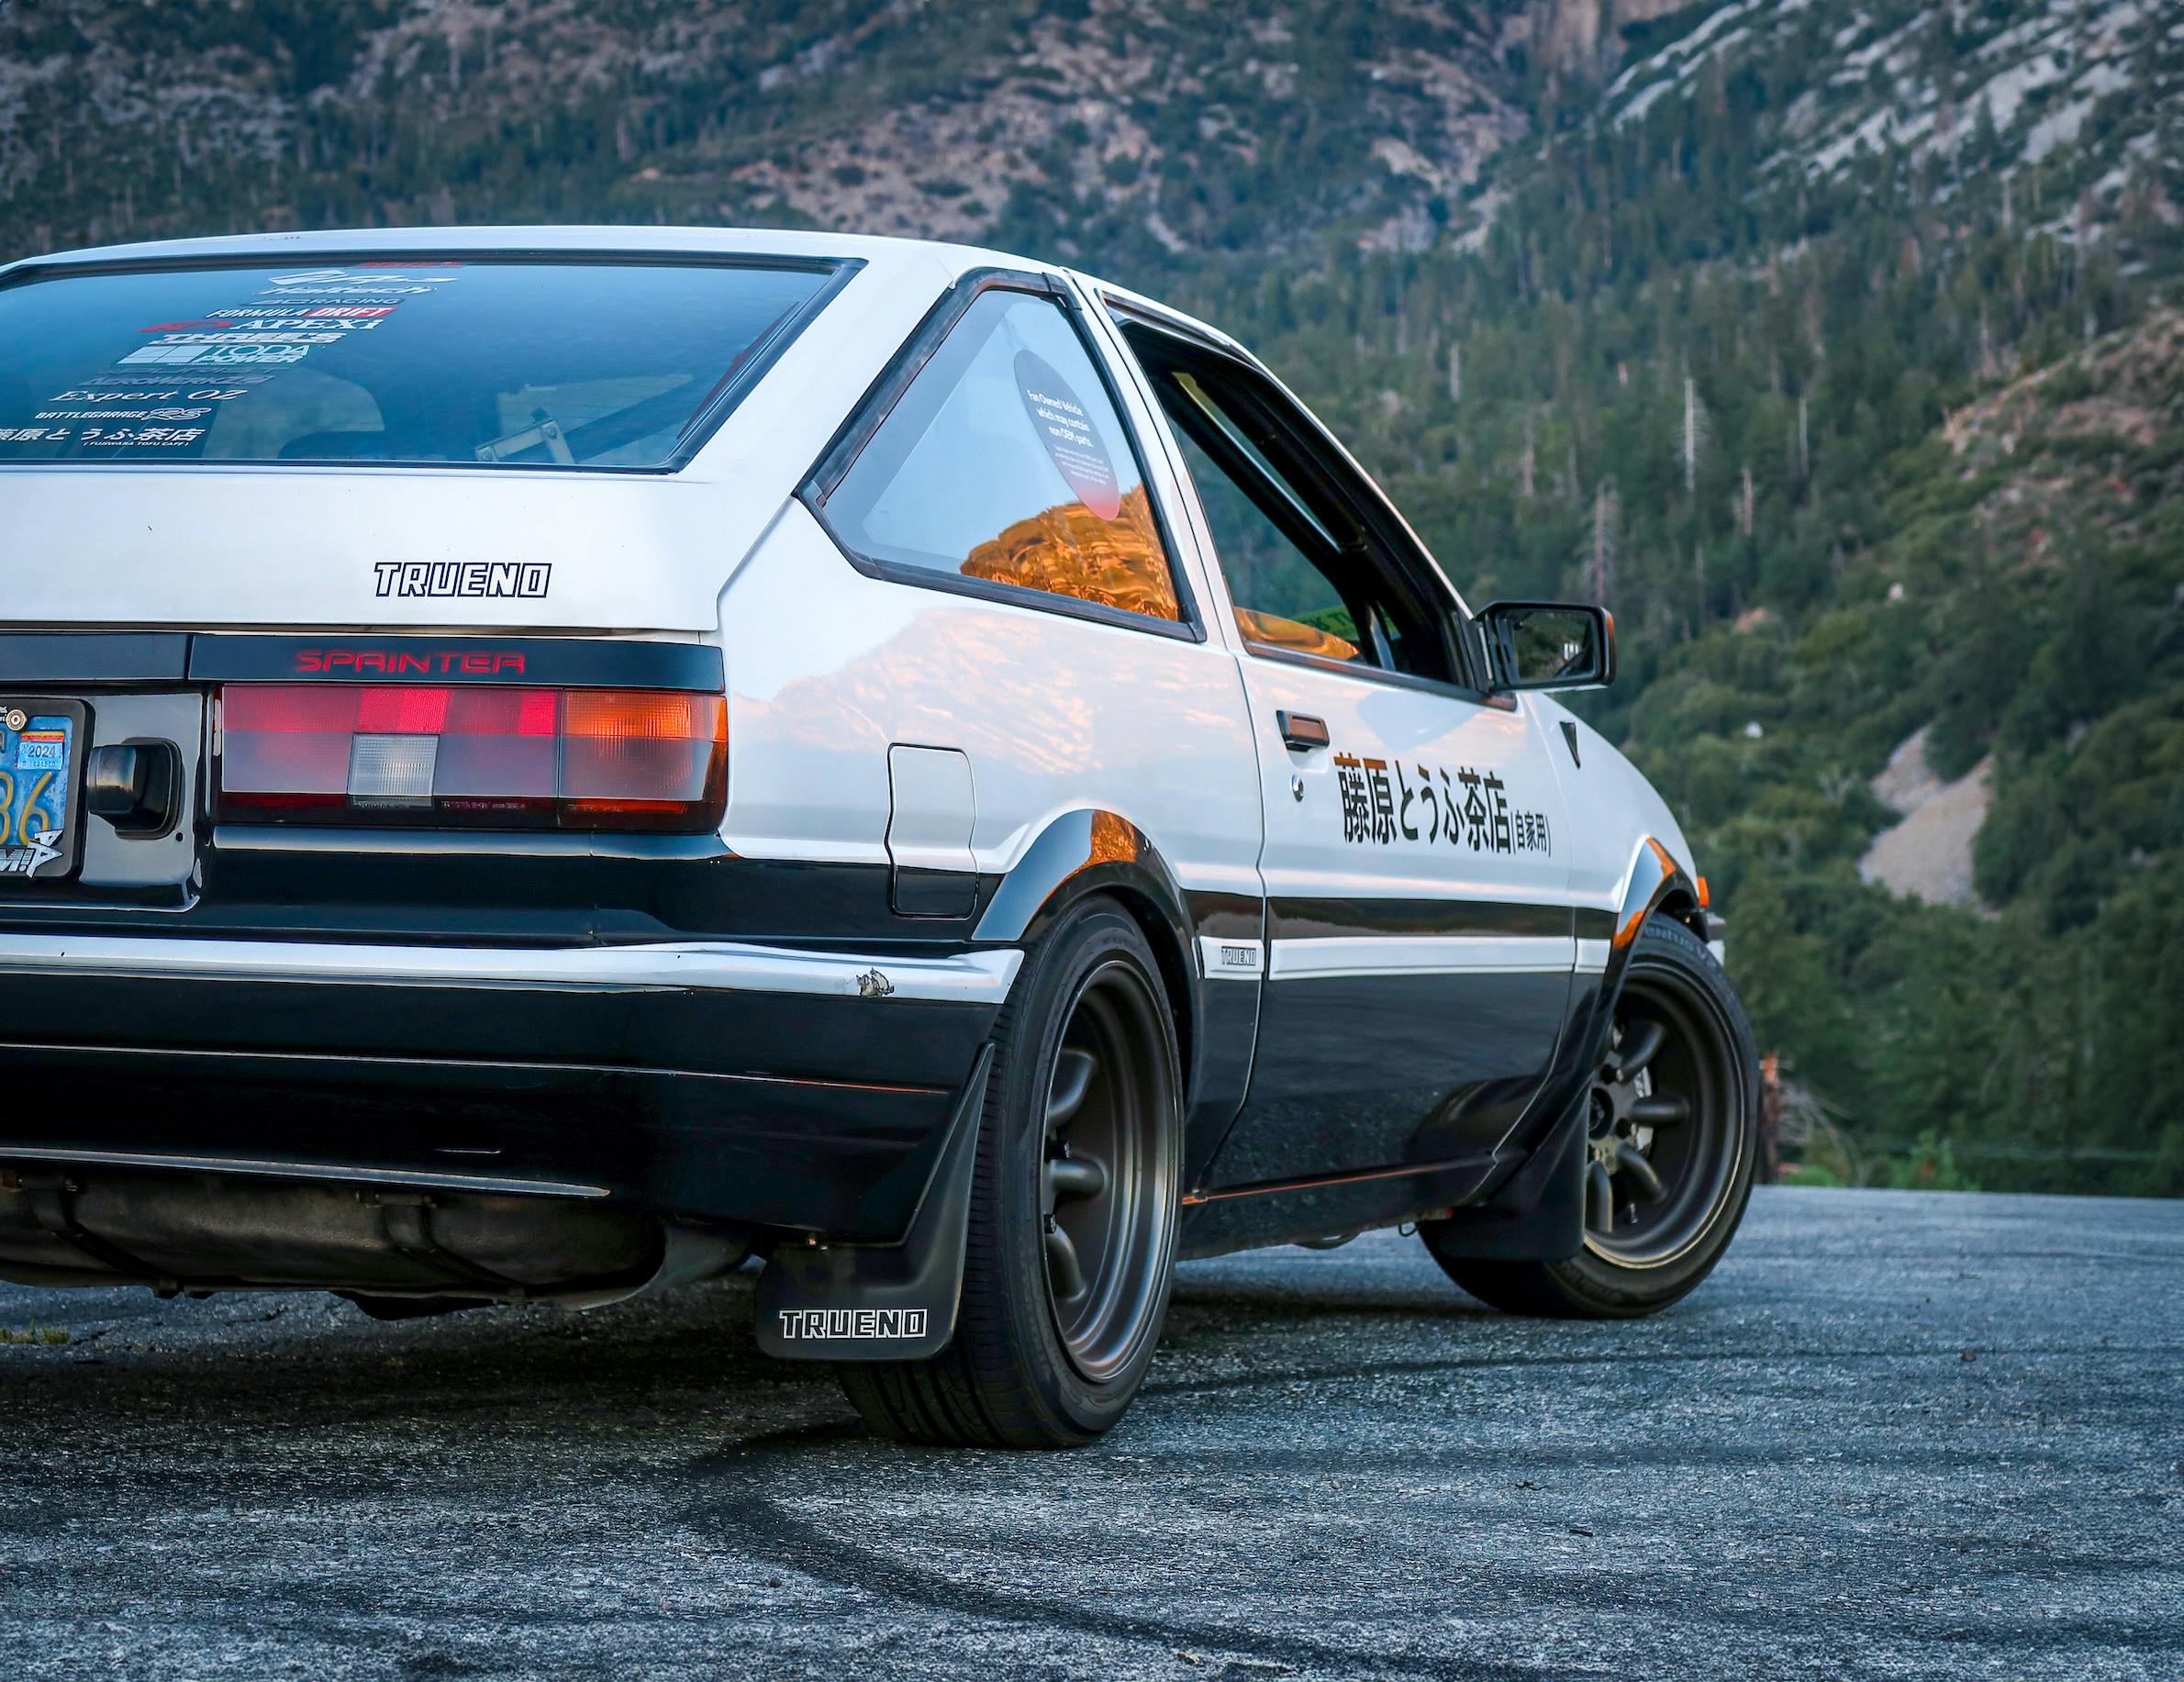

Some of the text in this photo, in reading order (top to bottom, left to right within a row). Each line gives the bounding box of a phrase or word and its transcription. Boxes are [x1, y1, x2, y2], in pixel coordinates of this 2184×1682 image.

[206, 306, 393, 318] FORMULA DRIFT
[213, 344, 310, 356] TODA
[193, 354, 304, 363] POWER
[49, 390, 179, 402] Expert
[35, 411, 147, 419] BATTLEGARAGE
[374, 562, 552, 598] TRUENO
[294, 650, 527, 675] SPRINTER
[28, 745, 56, 758] 2024
[1221, 946, 1257, 966] TRUENO
[779, 1309, 929, 1340] TRUENO
